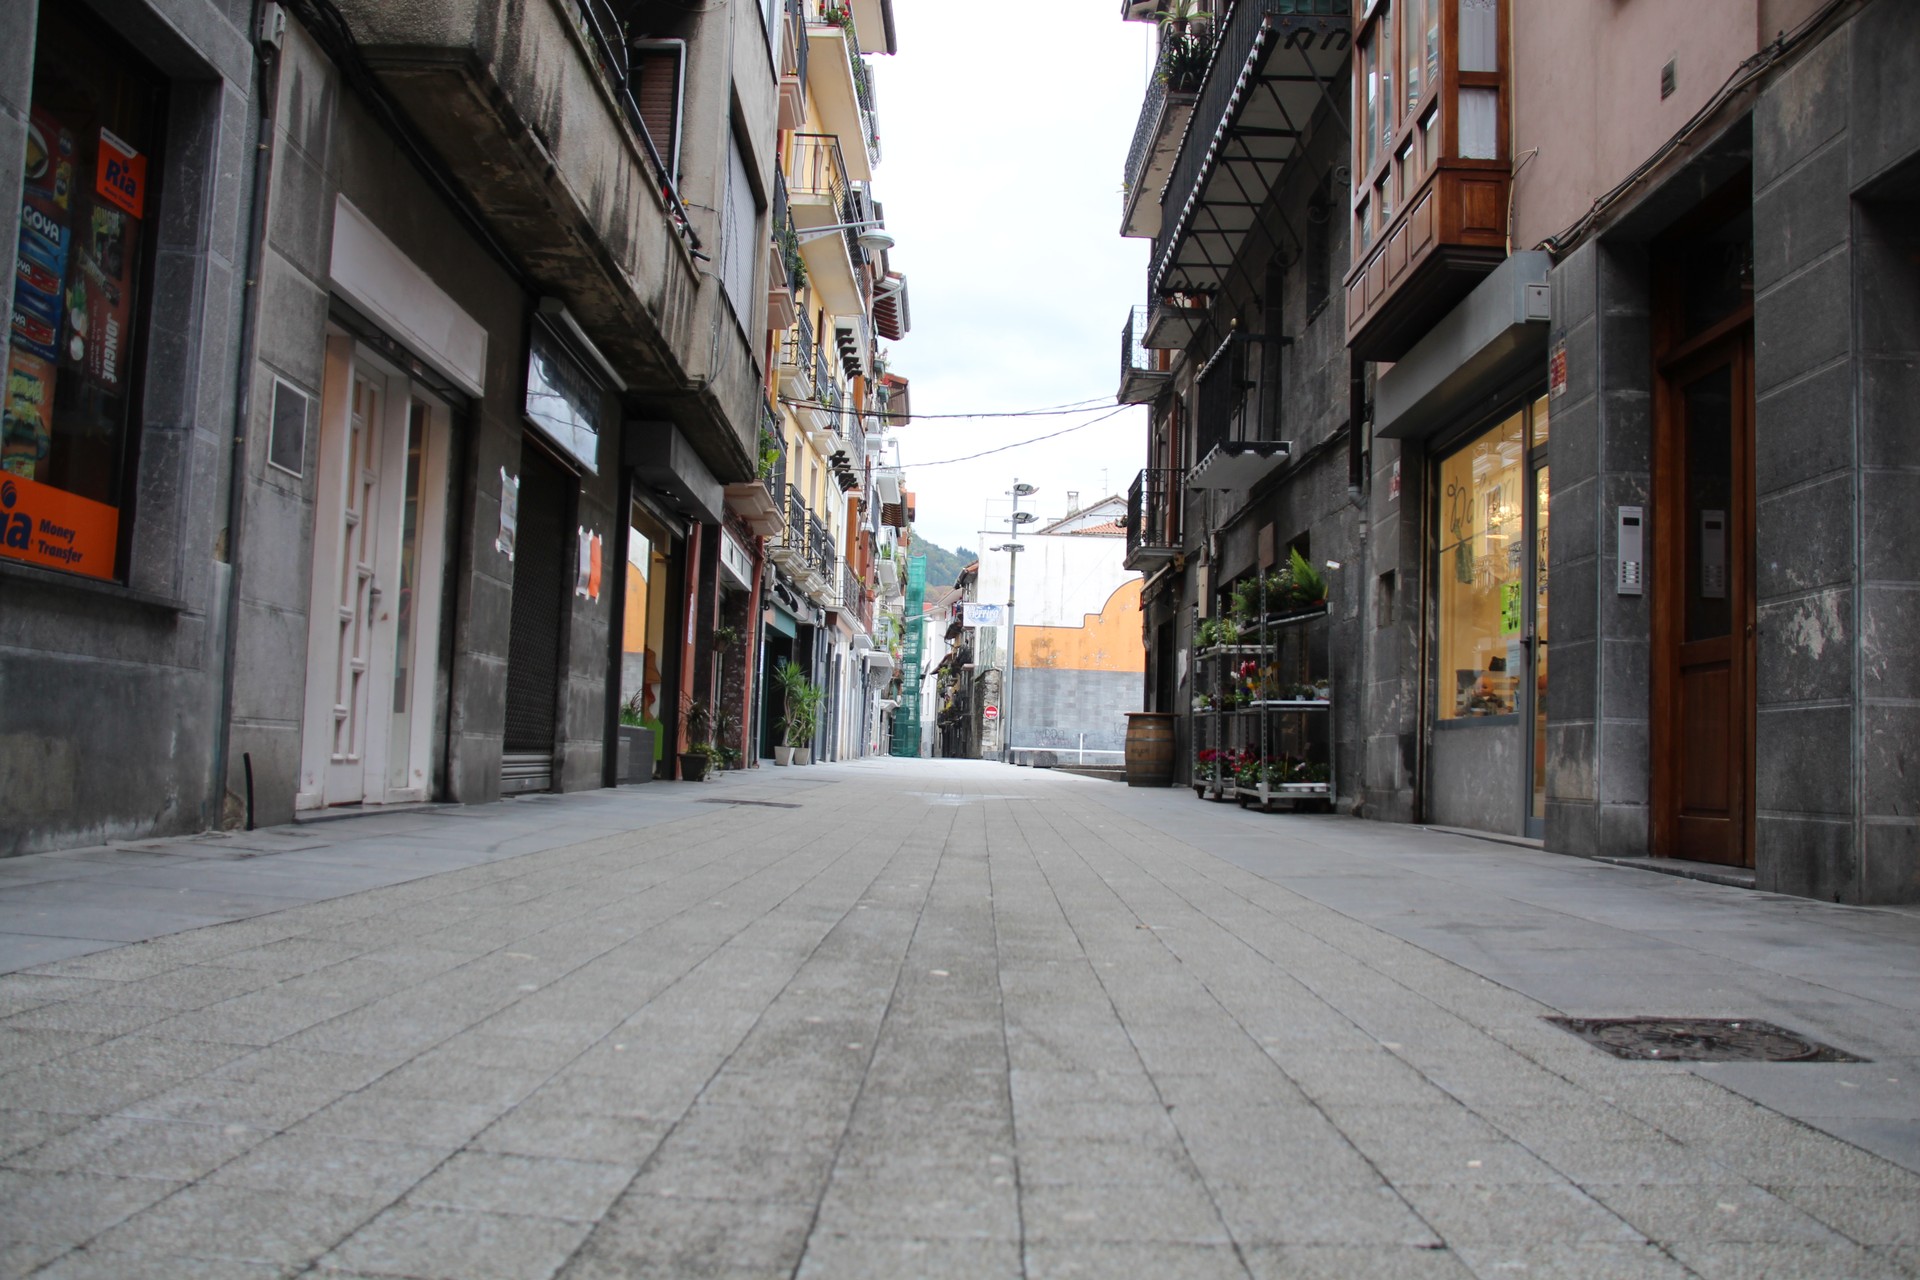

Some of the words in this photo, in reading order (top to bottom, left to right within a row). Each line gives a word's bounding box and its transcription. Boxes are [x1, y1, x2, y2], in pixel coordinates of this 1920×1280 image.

[106, 160, 136, 198] Ria
[23, 205, 60, 242] GOYA
[102, 312, 119, 384] JONGUÉ
[39, 518, 76, 544] Money
[38, 539, 83, 564] Transfer
